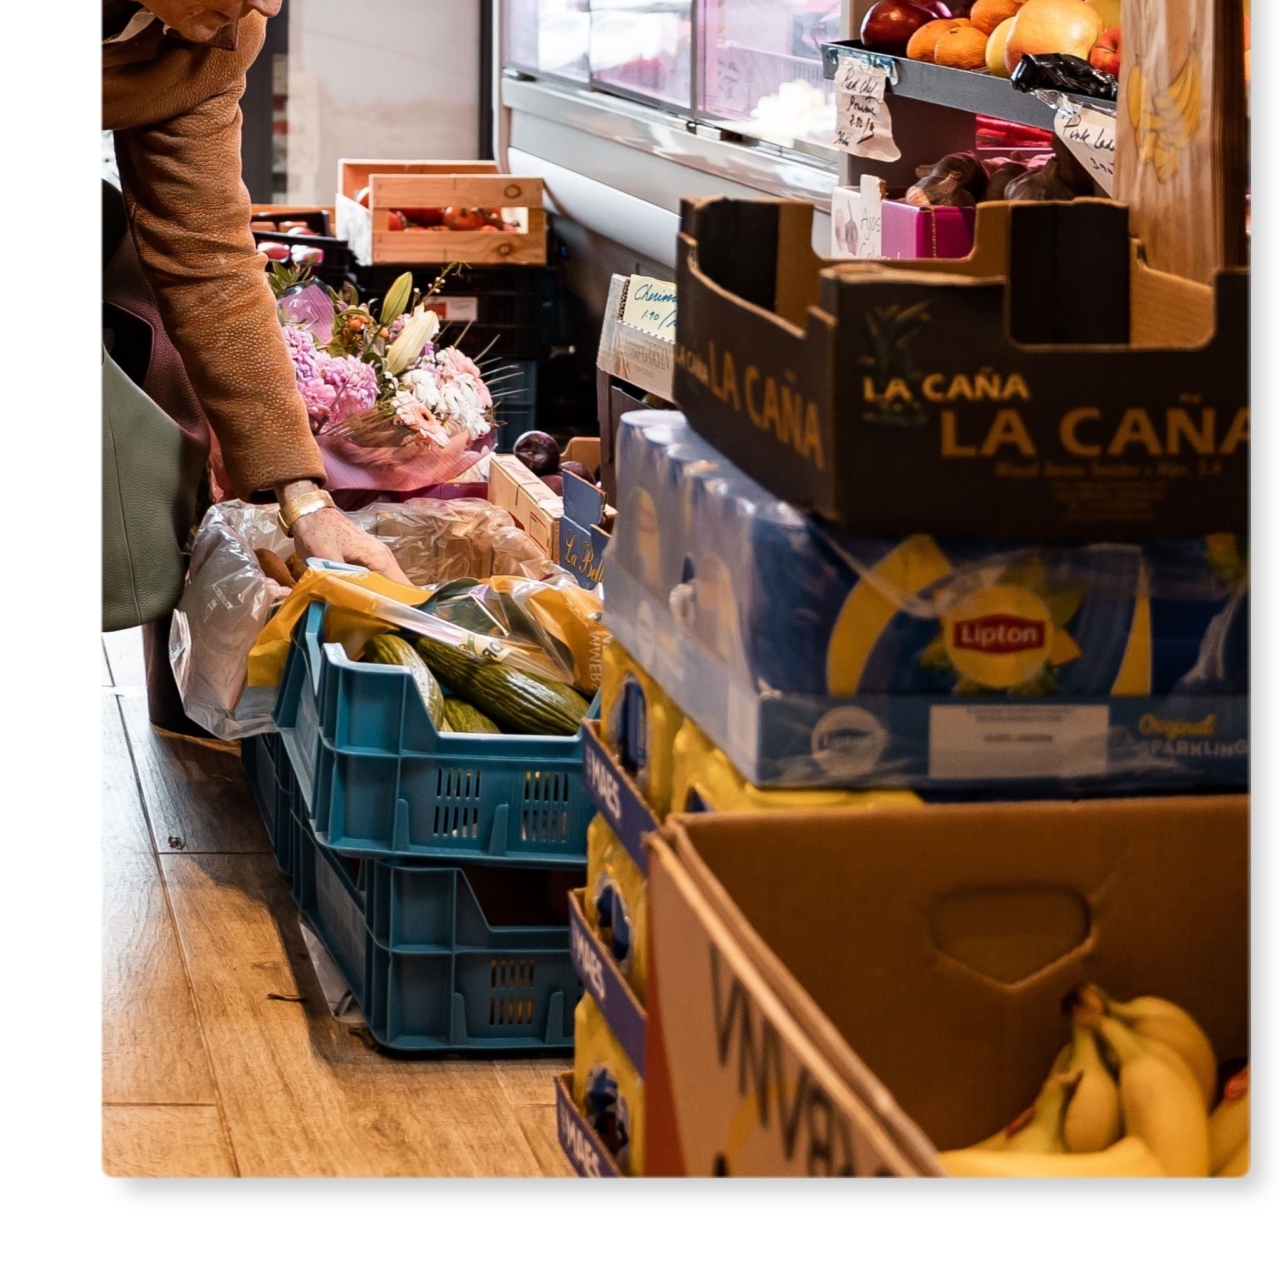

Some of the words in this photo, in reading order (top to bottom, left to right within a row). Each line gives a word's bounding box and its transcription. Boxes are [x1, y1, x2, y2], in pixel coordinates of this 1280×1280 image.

[862, 377, 913, 402] LA
[940, 407, 1037, 458] LA
[961, 624, 1038, 648] Lipton
